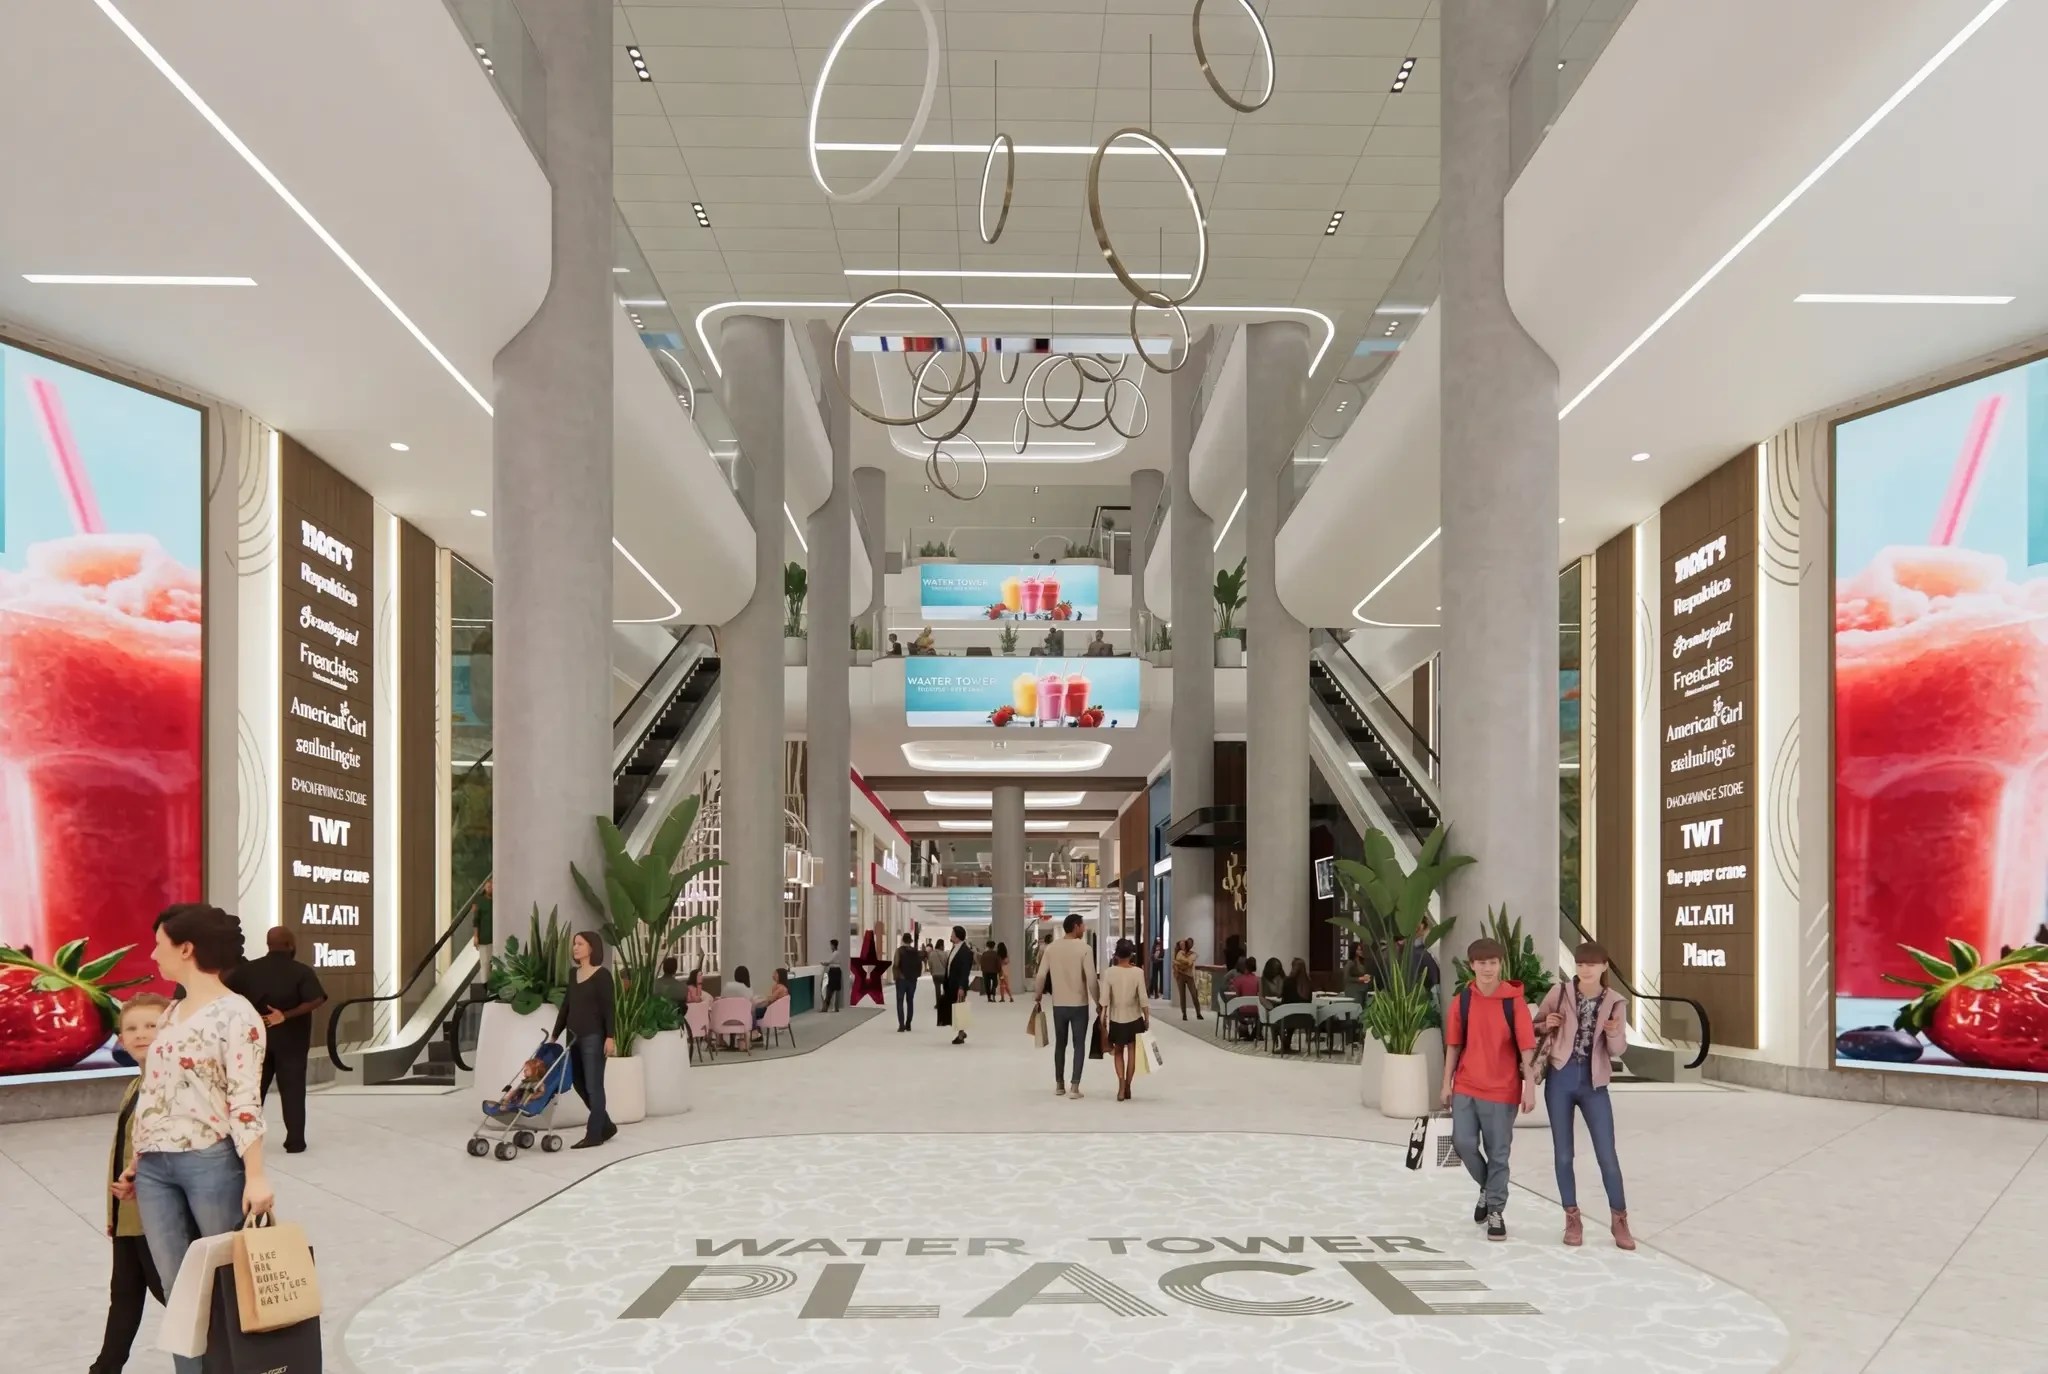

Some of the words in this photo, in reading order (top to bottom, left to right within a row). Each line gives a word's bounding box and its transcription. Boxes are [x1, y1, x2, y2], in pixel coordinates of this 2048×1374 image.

[290, 696, 346, 731] American
[1666, 714, 1718, 743] American
[1718, 781, 1744, 799] STORE
[308, 814, 351, 847] TWT
[1680, 818, 1724, 849] TWT
[1666, 868, 1684, 886] the
[302, 902, 359, 926] ALT.ATH
[1675, 903, 1734, 926] ALT.ATH
[696, 1237, 1032, 1257] WATER
[1088, 1235, 1446, 1255] TOWER
[617, 1260, 1543, 1319] PLACE
